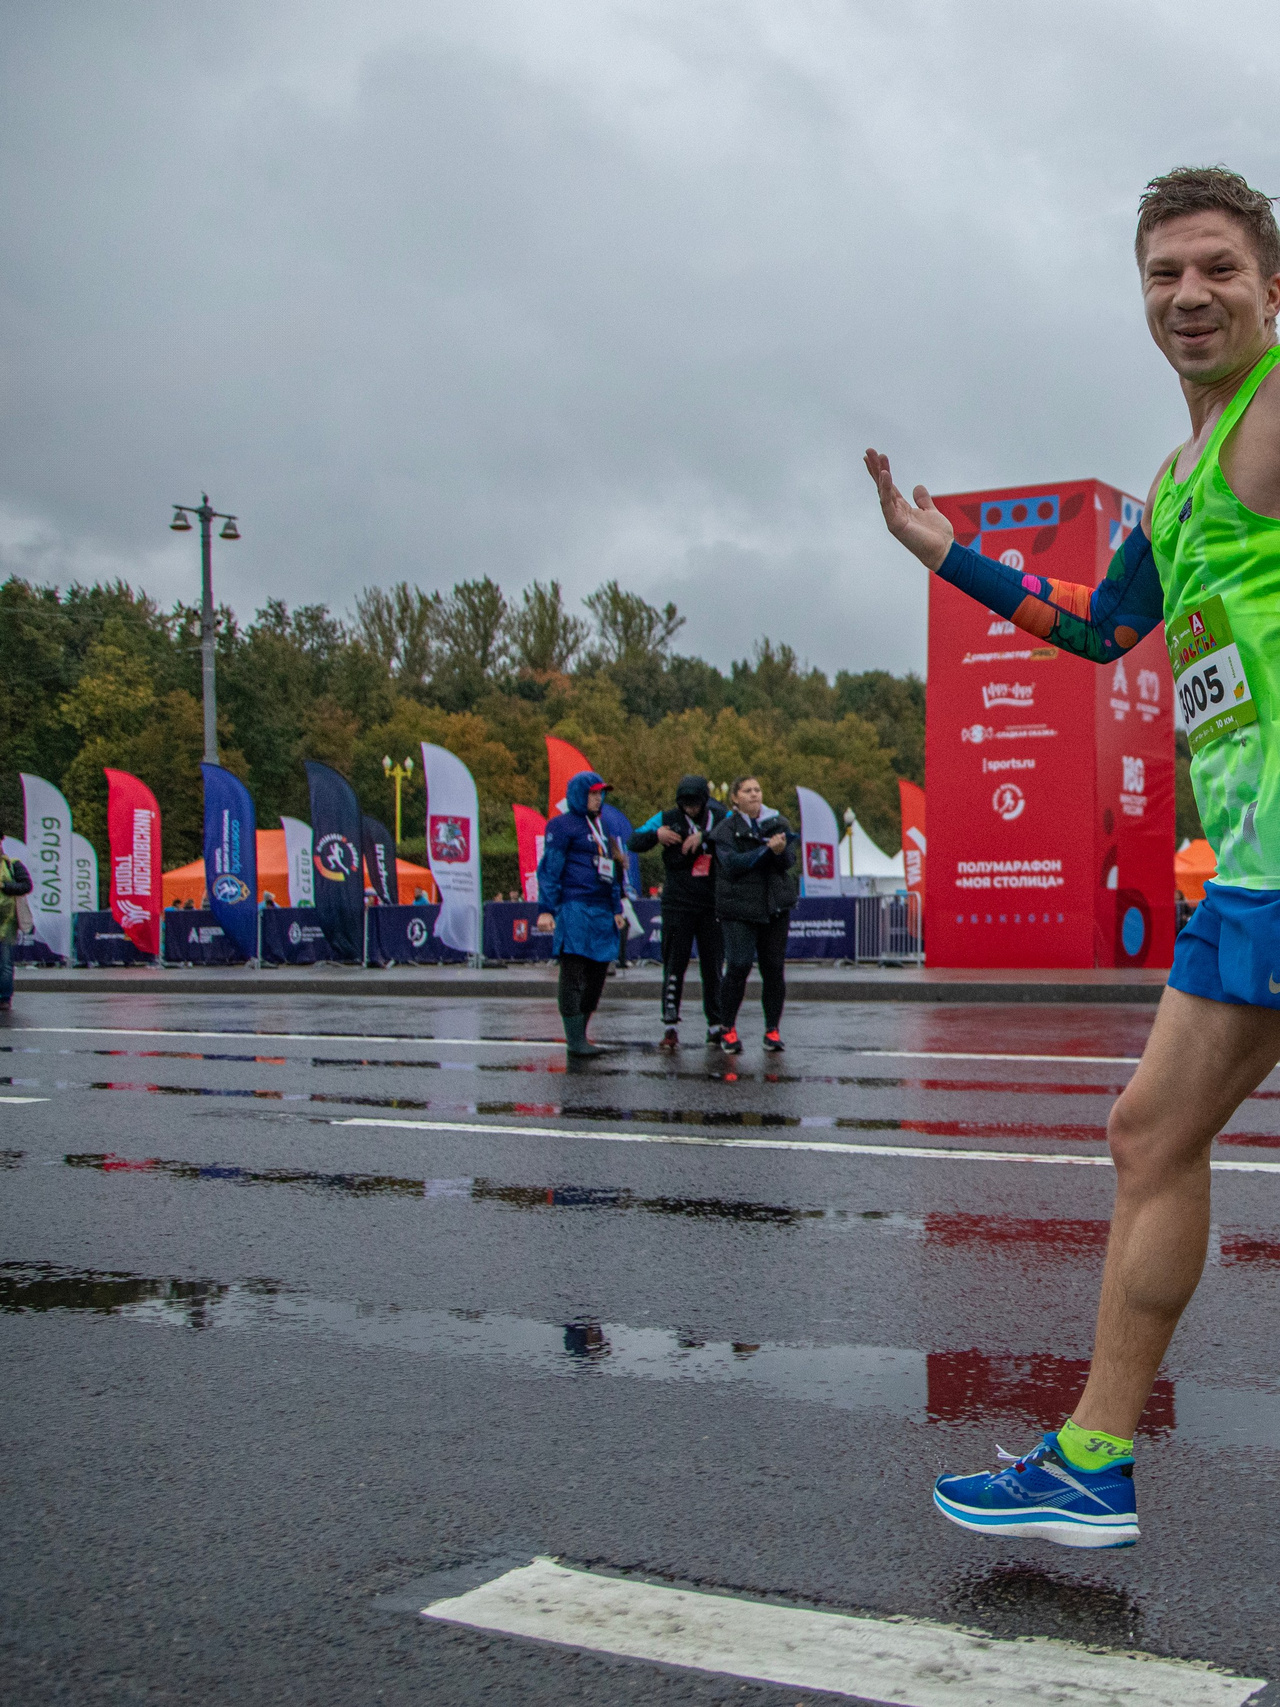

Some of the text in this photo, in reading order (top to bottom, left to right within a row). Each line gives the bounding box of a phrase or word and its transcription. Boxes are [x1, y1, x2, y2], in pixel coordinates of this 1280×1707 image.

[1215, 719, 1224, 729] 10
[987, 758, 1035, 773] sports.ru
[958, 860, 1062, 873] ПОЛУМАРАФОН
[955, 875, 1064, 889] «МОЯ СТОЛИЦА»
[790, 918, 845, 930] олумарафон
